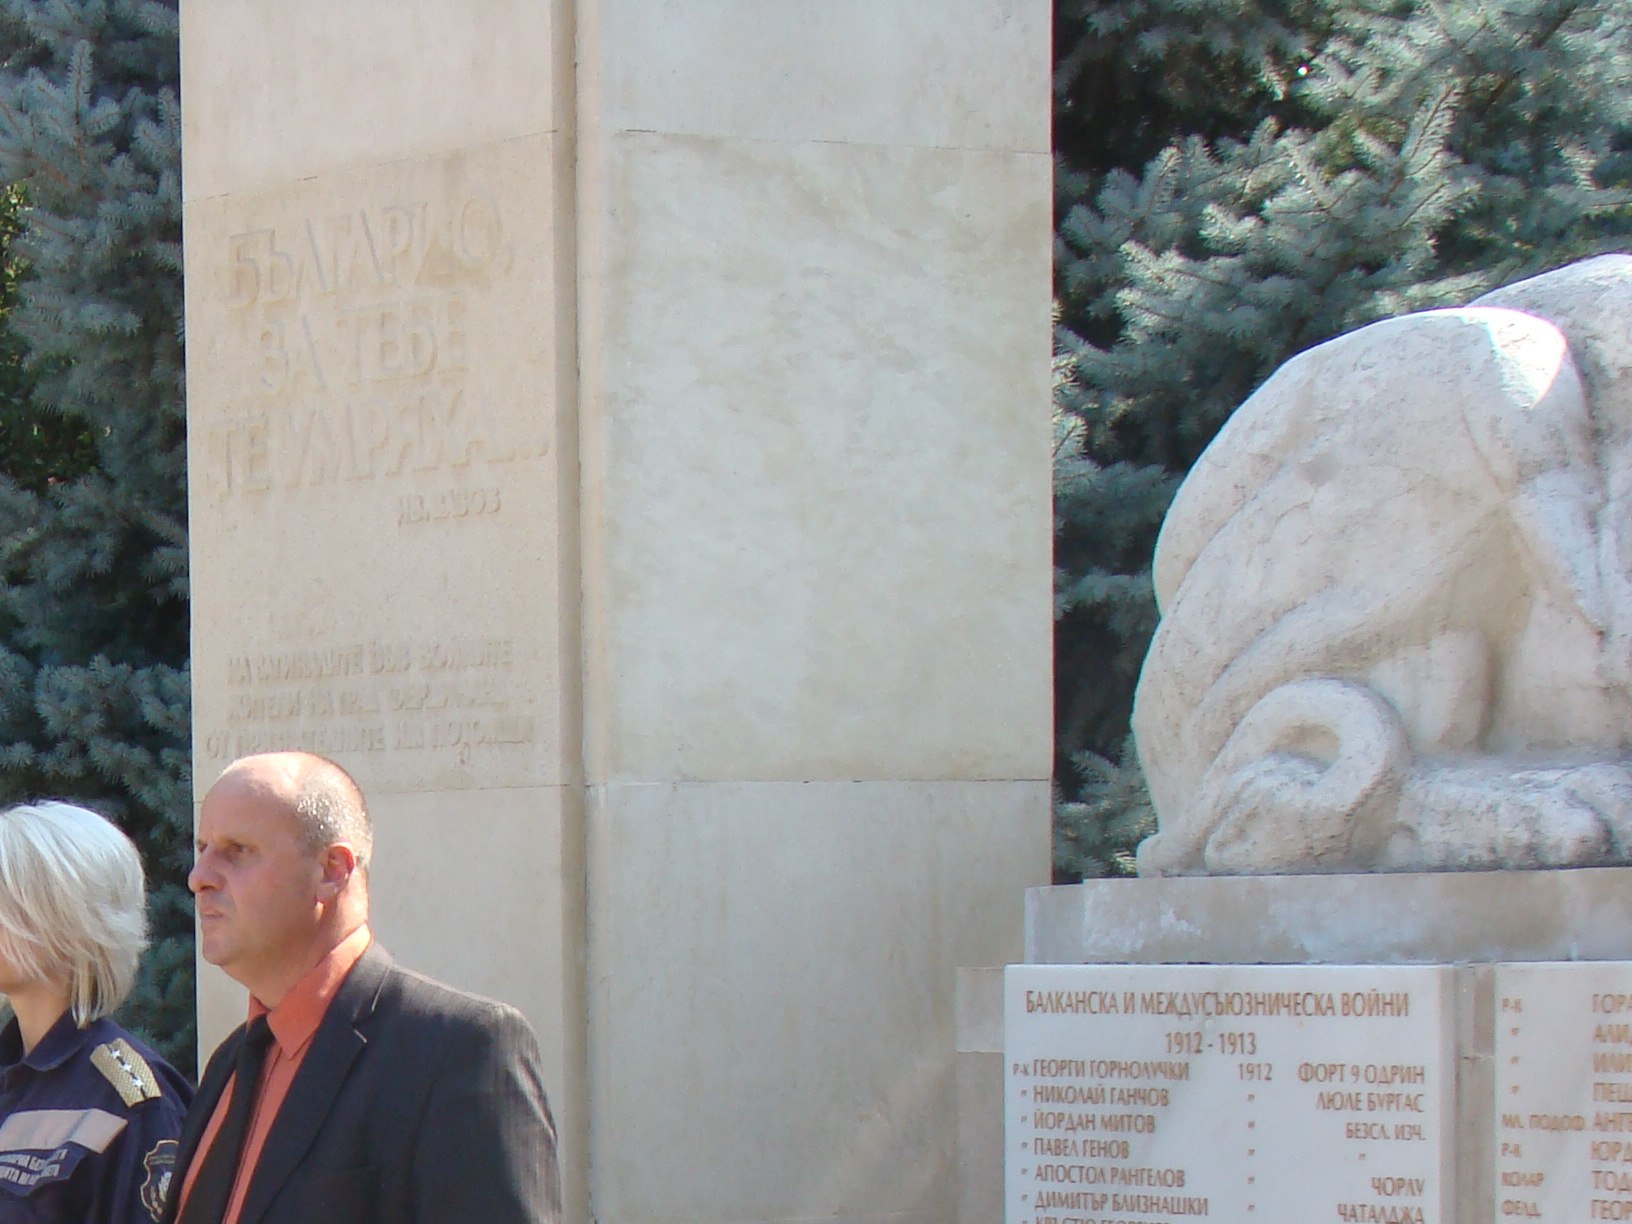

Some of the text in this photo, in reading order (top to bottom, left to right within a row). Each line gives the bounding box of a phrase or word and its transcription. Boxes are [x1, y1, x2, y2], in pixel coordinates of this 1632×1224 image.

[1025, 988, 1410, 1019] БАЛКАНСКА И МЕЖДУСЪЮЗНИЧЕСКА ВОЙНИ
[1165, 1031, 1257, 1055] 1912 1913
[1032, 1059, 1085, 1078] ГЕОРГИ
[1237, 1063, 1273, 1081] 1912
[1297, 1062, 1345, 1082] ФОРТ
[1364, 1064, 1425, 1086] ОДРИН
[1033, 1084, 1169, 1106] НИКОЛАЙ ГАНЧОВ
[1316, 1092, 1425, 1112] ЛЮЛЕ БУРГАС
[1034, 1109, 1155, 1133] ЙОРДАН МИТОВ
[1034, 1138, 1129, 1158] ПАВЕЛ ГЕНОВ
[1035, 1164, 1185, 1187] АПОСТОЛ РАНГЕЛОВ
[1371, 1177, 1425, 1196] ЧОРЛУ
[1034, 1191, 1209, 1215] ДИМИТЪР БЛИЗНАШКИ
